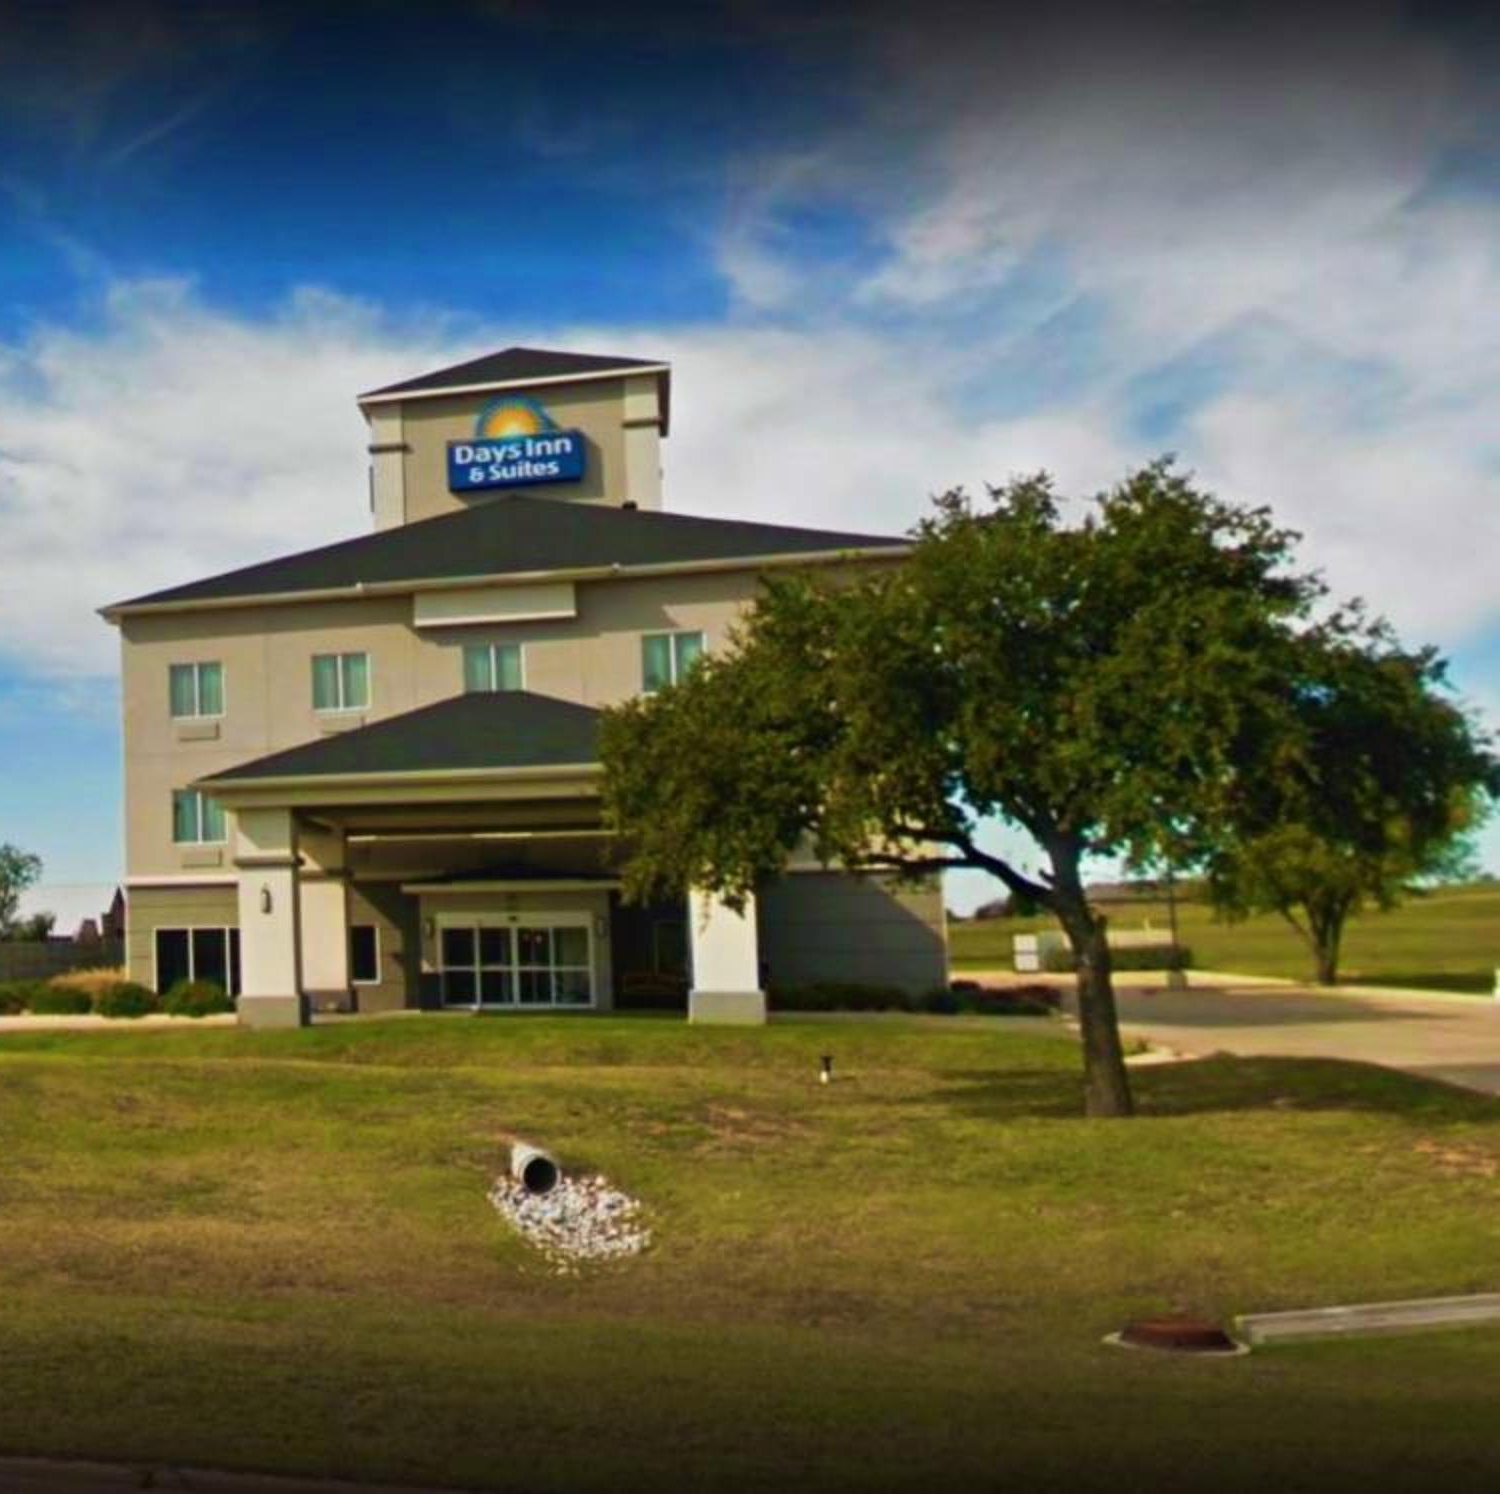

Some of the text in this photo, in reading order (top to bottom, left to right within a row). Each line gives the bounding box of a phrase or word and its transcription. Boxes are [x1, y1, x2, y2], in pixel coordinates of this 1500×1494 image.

[454, 437, 573, 464] Days Inn
[469, 460, 560, 482] & Suites
